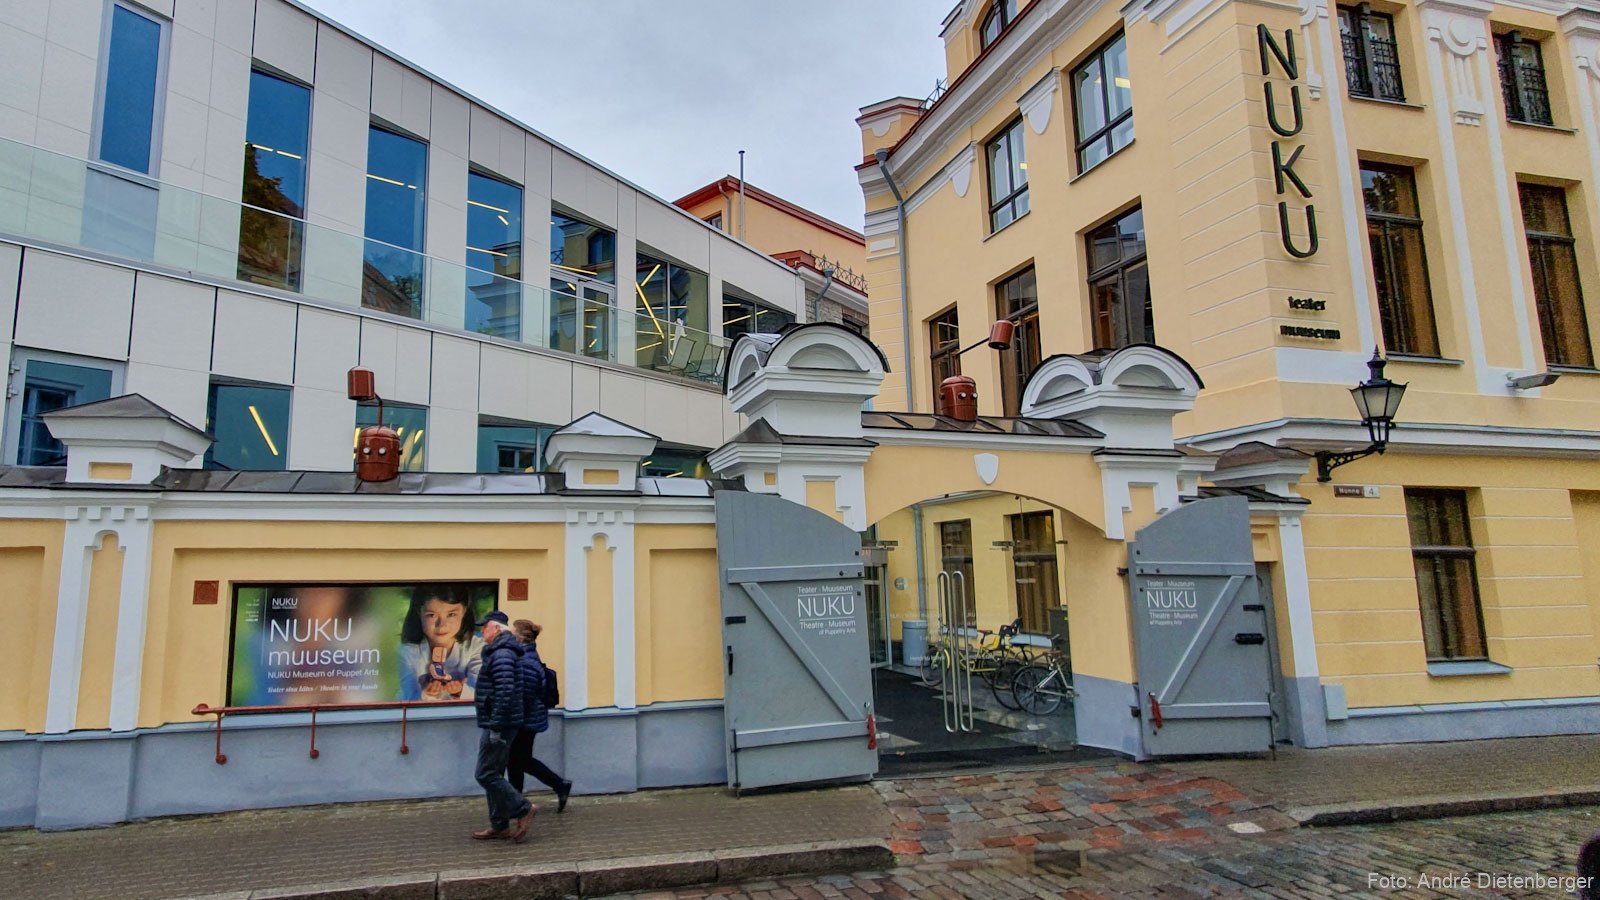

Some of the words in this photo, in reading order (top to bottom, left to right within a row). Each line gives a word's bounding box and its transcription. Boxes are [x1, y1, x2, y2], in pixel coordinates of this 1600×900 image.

[1257, 24, 1319, 258] NUKU
[1288, 296, 1326, 311] teater
[1280, 325, 1341, 340] muuseum
[798, 586, 817, 594] Teater
[272, 597, 298, 606] NUKU
[797, 595, 855, 618] NUKU
[1146, 590, 1197, 608] NUKU
[270, 617, 353, 643] NUKU
[800, 621, 824, 629] Theatre
[269, 649, 380, 666] muuseum
[268, 671, 291, 679] NUKU
[327, 669, 334, 677] of
[336, 669, 362, 678] Puppet
